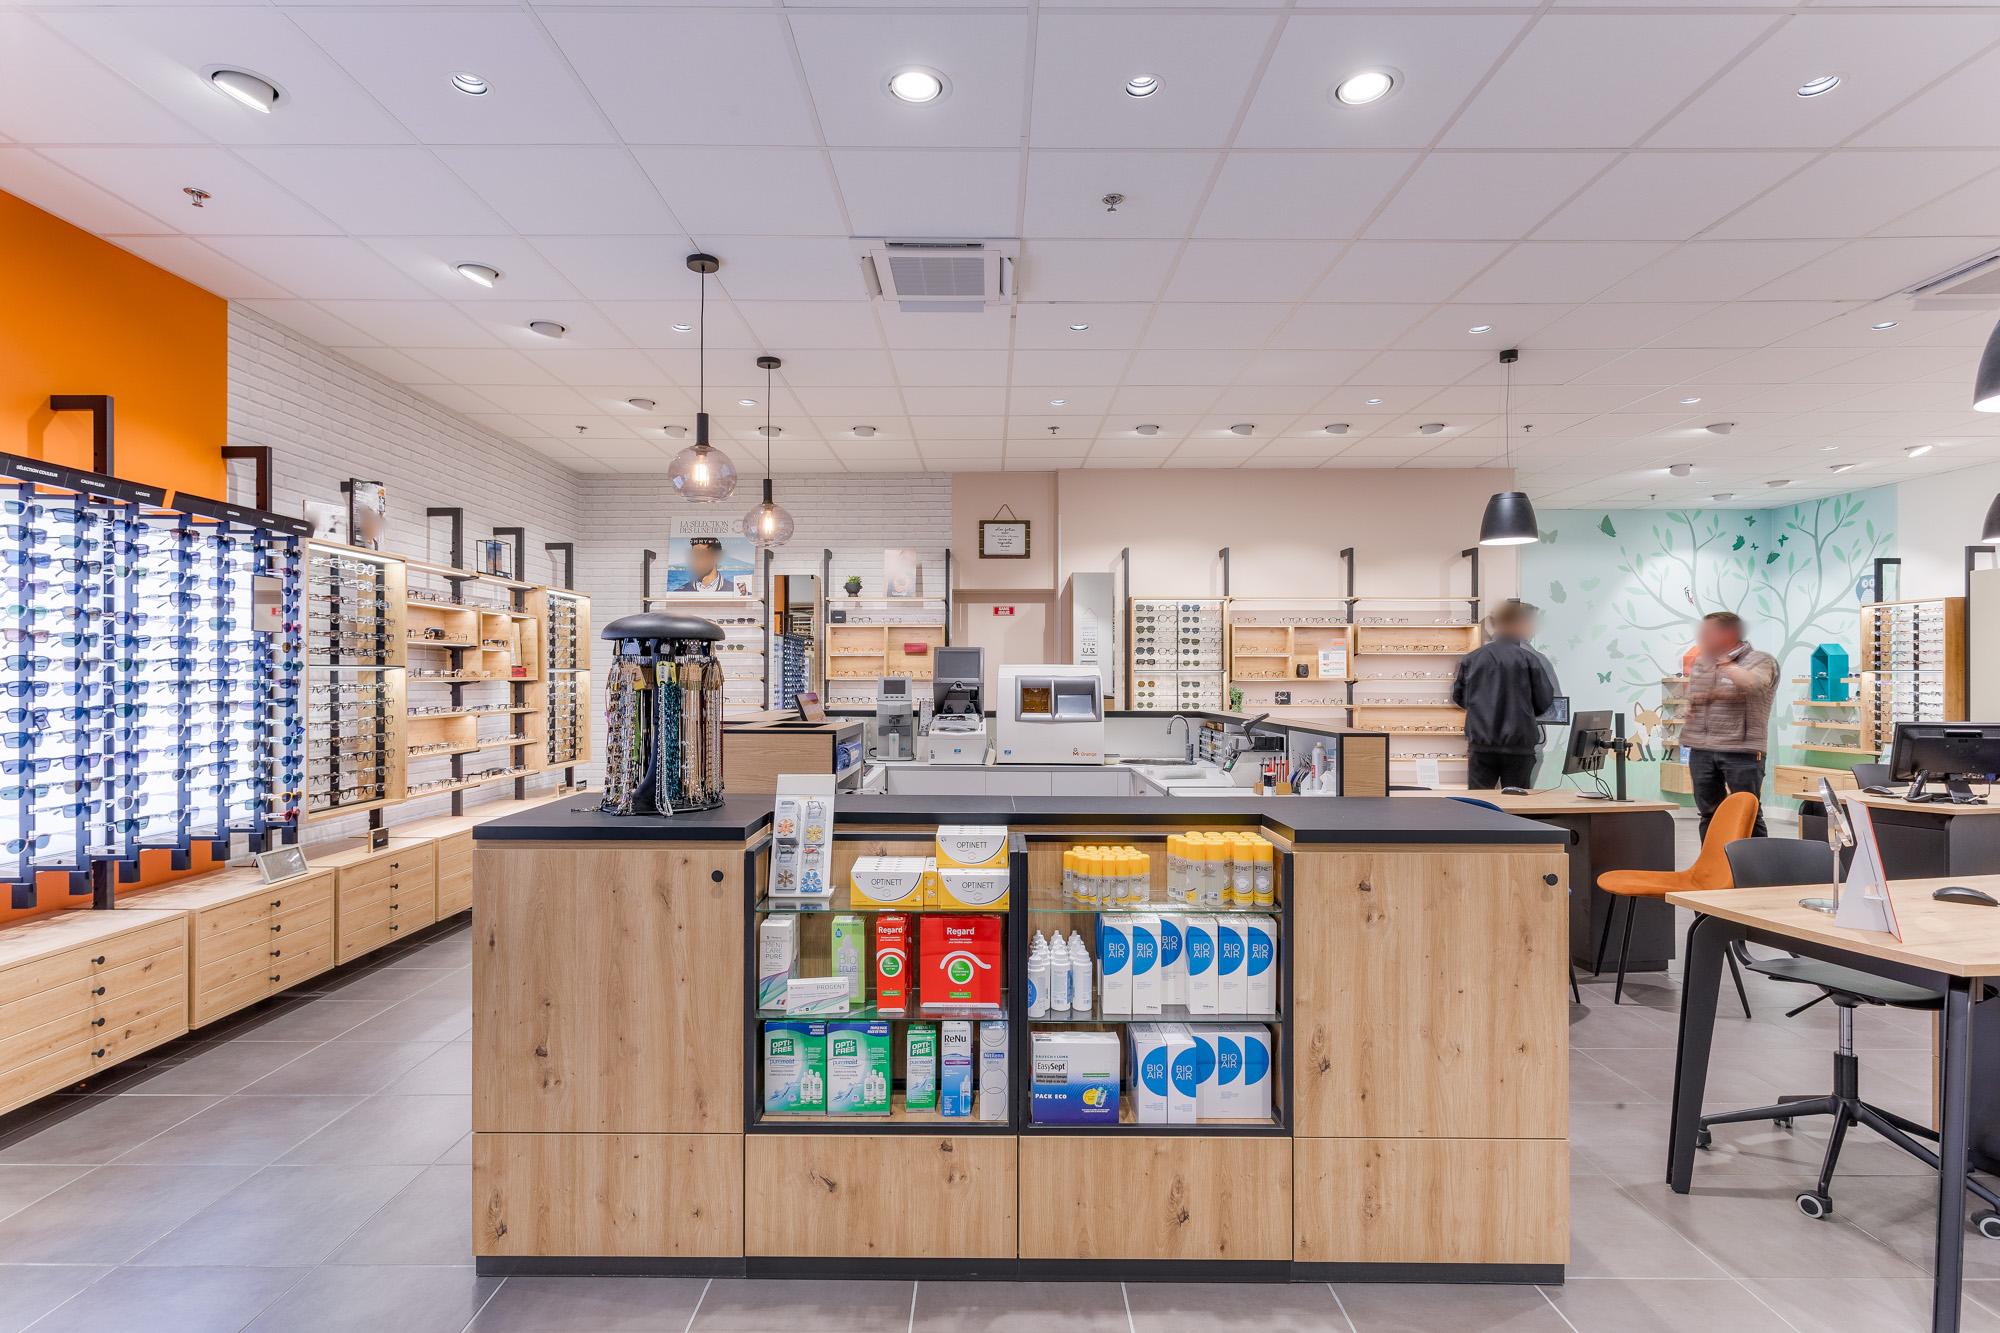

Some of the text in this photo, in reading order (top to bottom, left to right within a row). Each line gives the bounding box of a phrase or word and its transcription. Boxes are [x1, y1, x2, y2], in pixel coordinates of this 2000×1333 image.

[871, 878, 902, 886] OPTINETT
[878, 926, 902, 934] Regard
[946, 927, 975, 936] Regard
[1194, 943, 1210, 951] BIO
[1224, 943, 1240, 951] BIO
[944, 1034, 967, 1043] ReNu
[772, 1040, 792, 1048] OPTI-
[836, 1041, 855, 1049] OPTI-
[836, 1047, 856, 1055] FREE
[1037, 1062, 1066, 1071] EasySept
[1147, 1064, 1163, 1072] BIO
[1176, 1065, 1192, 1073] BIO
